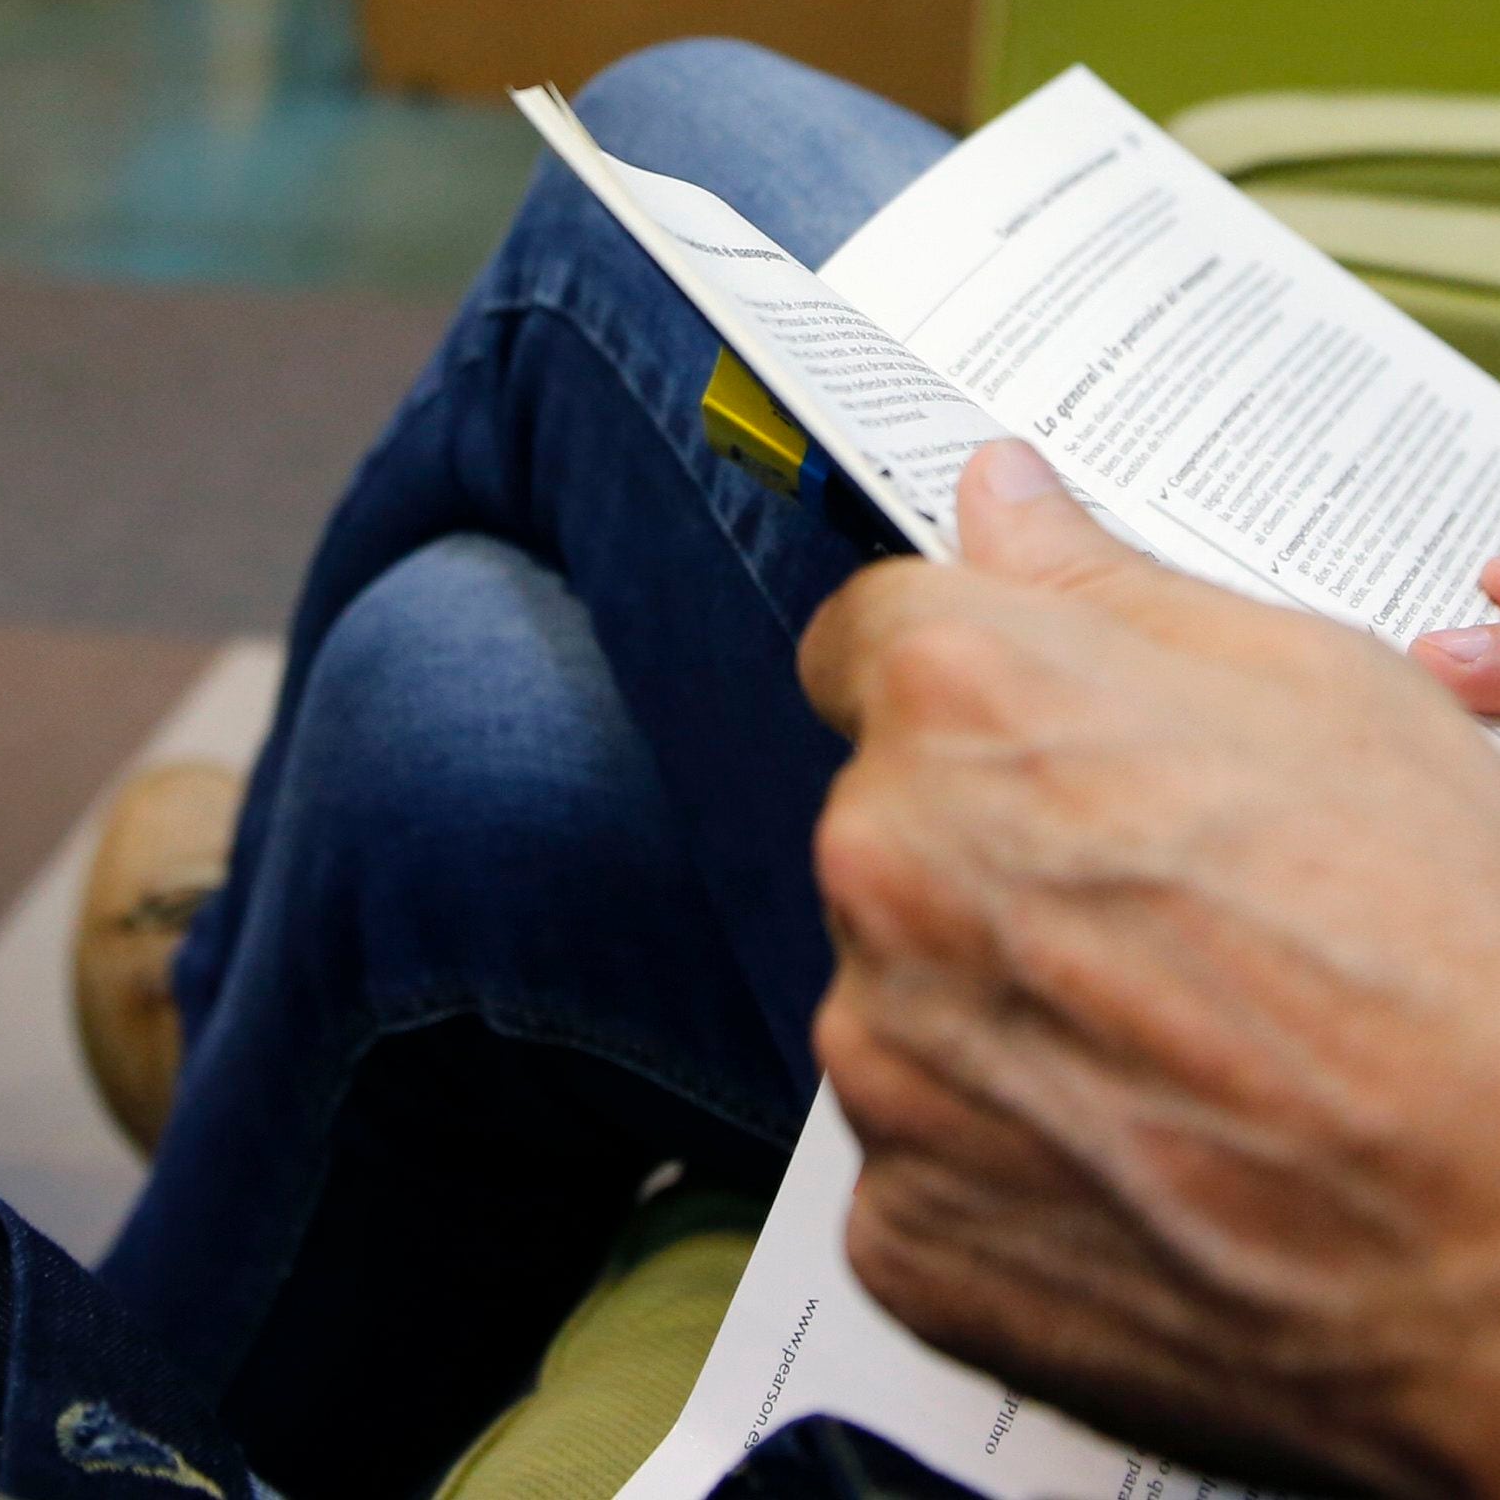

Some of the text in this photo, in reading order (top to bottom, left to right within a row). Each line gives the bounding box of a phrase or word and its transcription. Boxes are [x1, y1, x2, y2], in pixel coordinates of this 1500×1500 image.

[1033, 415, 1057, 437] Lo
[1057, 364, 1100, 418] general
[1097, 358, 1114, 372] y
[1064, 442, 1081, 455] Se
[1115, 452, 1150, 487] Gestión
[1146, 439, 1161, 452] de
[1167, 429, 1221, 487] Competencias
[1254, 532, 1266, 545] al
[1278, 502, 1328, 561] Competencias
[1297, 560, 1310, 576] go
[1326, 560, 1338, 570] y
[1331, 547, 1346, 560] de
[1313, 567, 1331, 585] dos
[1328, 565, 1358, 596] Dentro
[1353, 552, 1367, 565] de
[1373, 565, 1420, 624] Competencias
[1393, 602, 1420, 636] refieren
[744, 1299, 819, 1450] www.pearson.es
